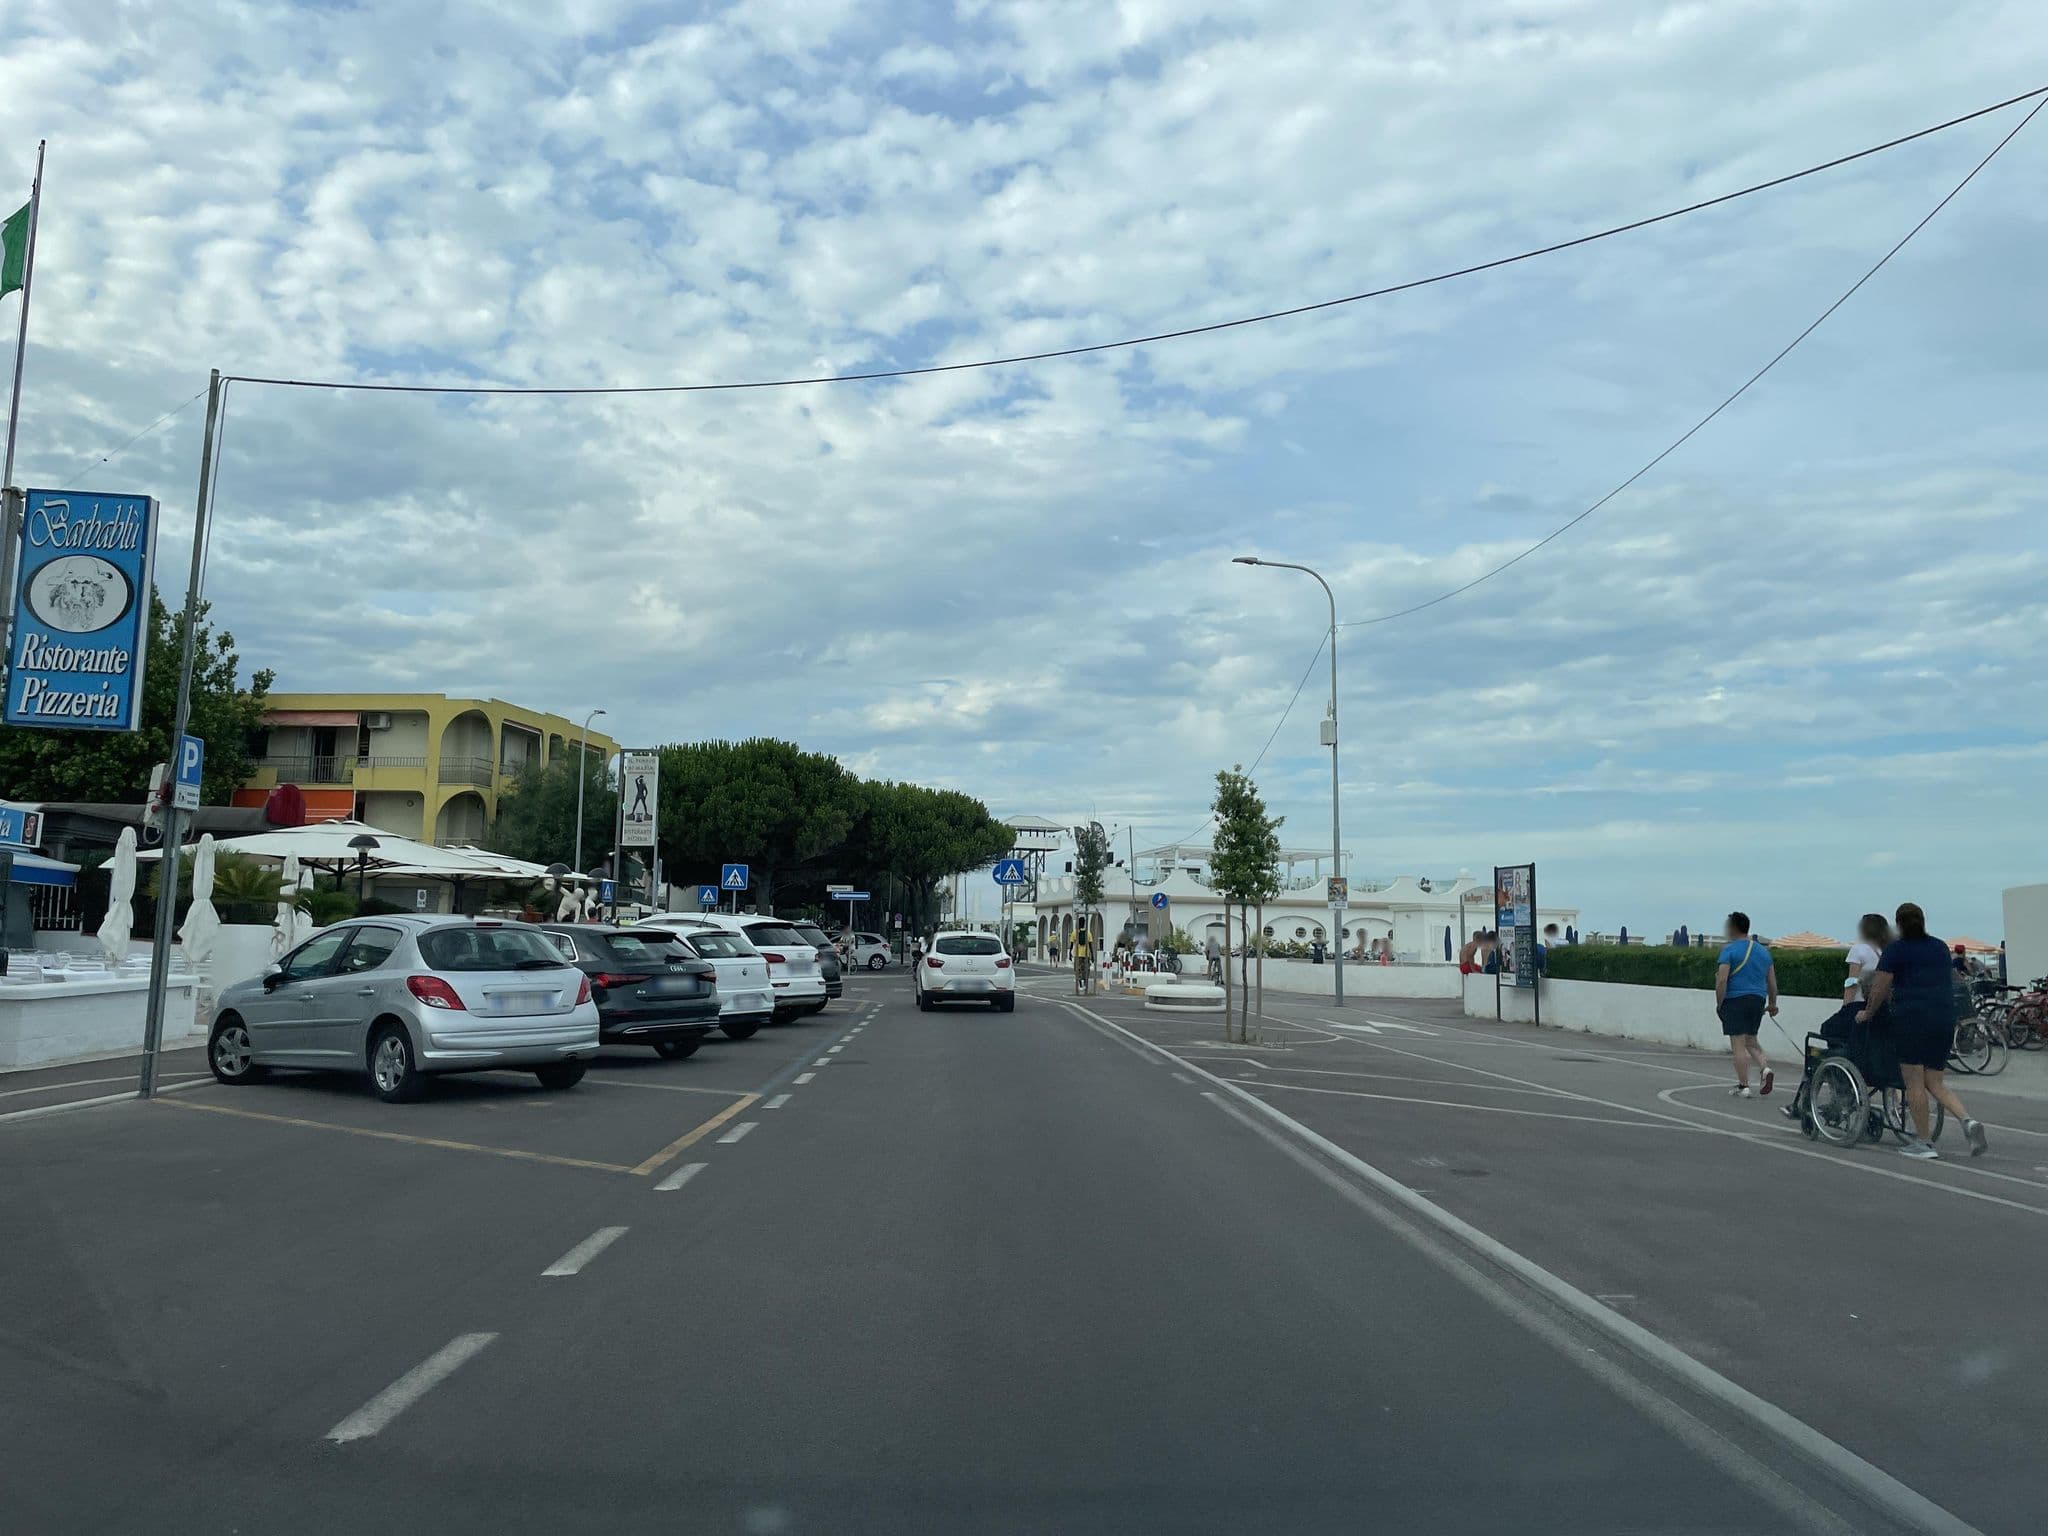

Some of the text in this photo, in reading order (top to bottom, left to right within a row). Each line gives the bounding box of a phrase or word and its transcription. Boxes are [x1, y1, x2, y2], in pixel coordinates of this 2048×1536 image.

[16, 632, 129, 674] Ristorante
[17, 677, 120, 719] Pizzeria
[182, 741, 199, 779] P
